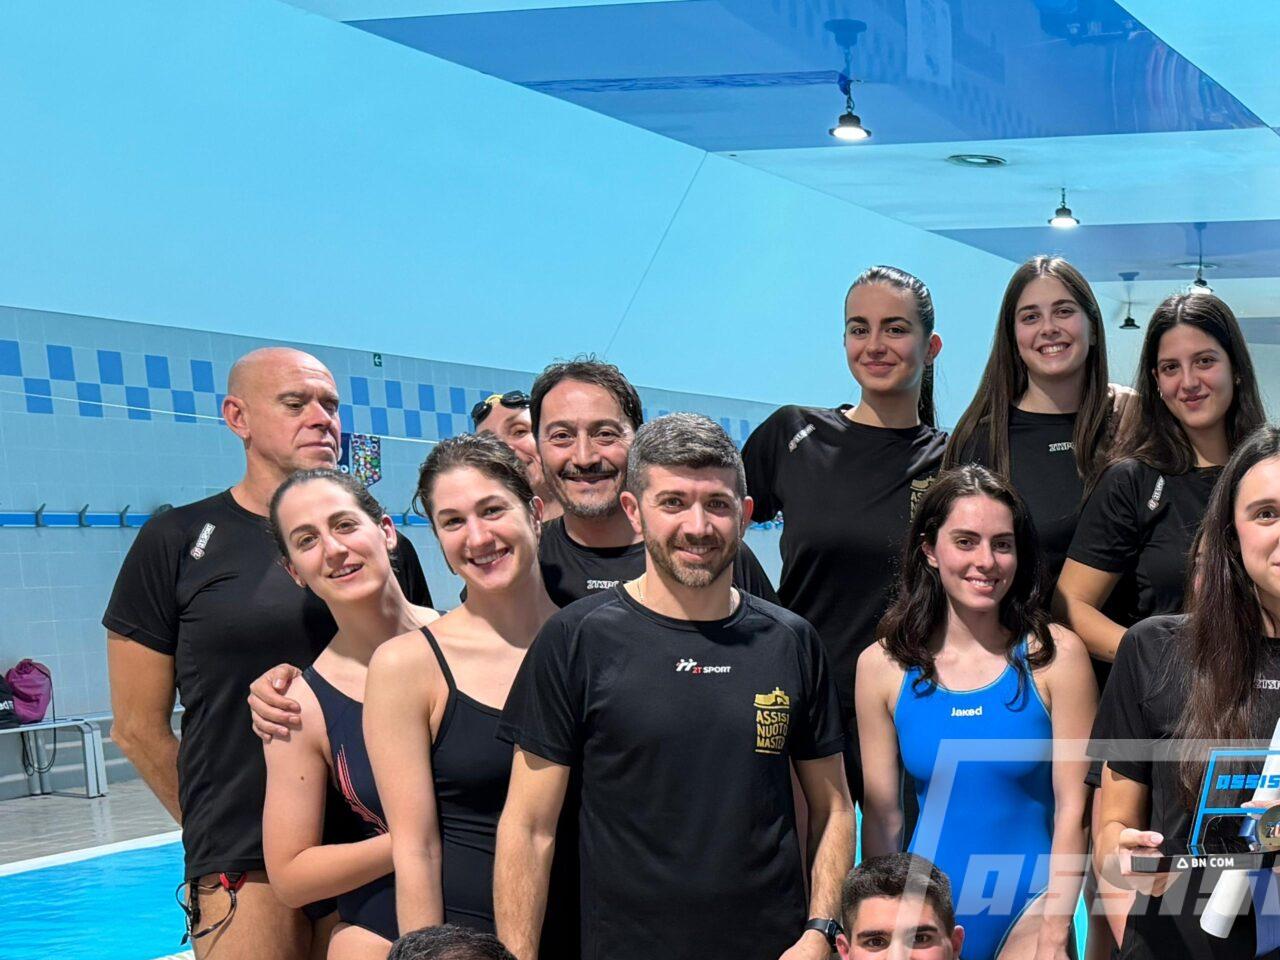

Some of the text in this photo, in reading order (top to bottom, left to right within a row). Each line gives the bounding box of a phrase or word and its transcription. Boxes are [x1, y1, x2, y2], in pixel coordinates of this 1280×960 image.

[703, 666, 731, 674] SPORT
[756, 709, 790, 725] ASSISI
[757, 723, 788, 737] NUOTO
[1191, 857, 1235, 868] BN COM
